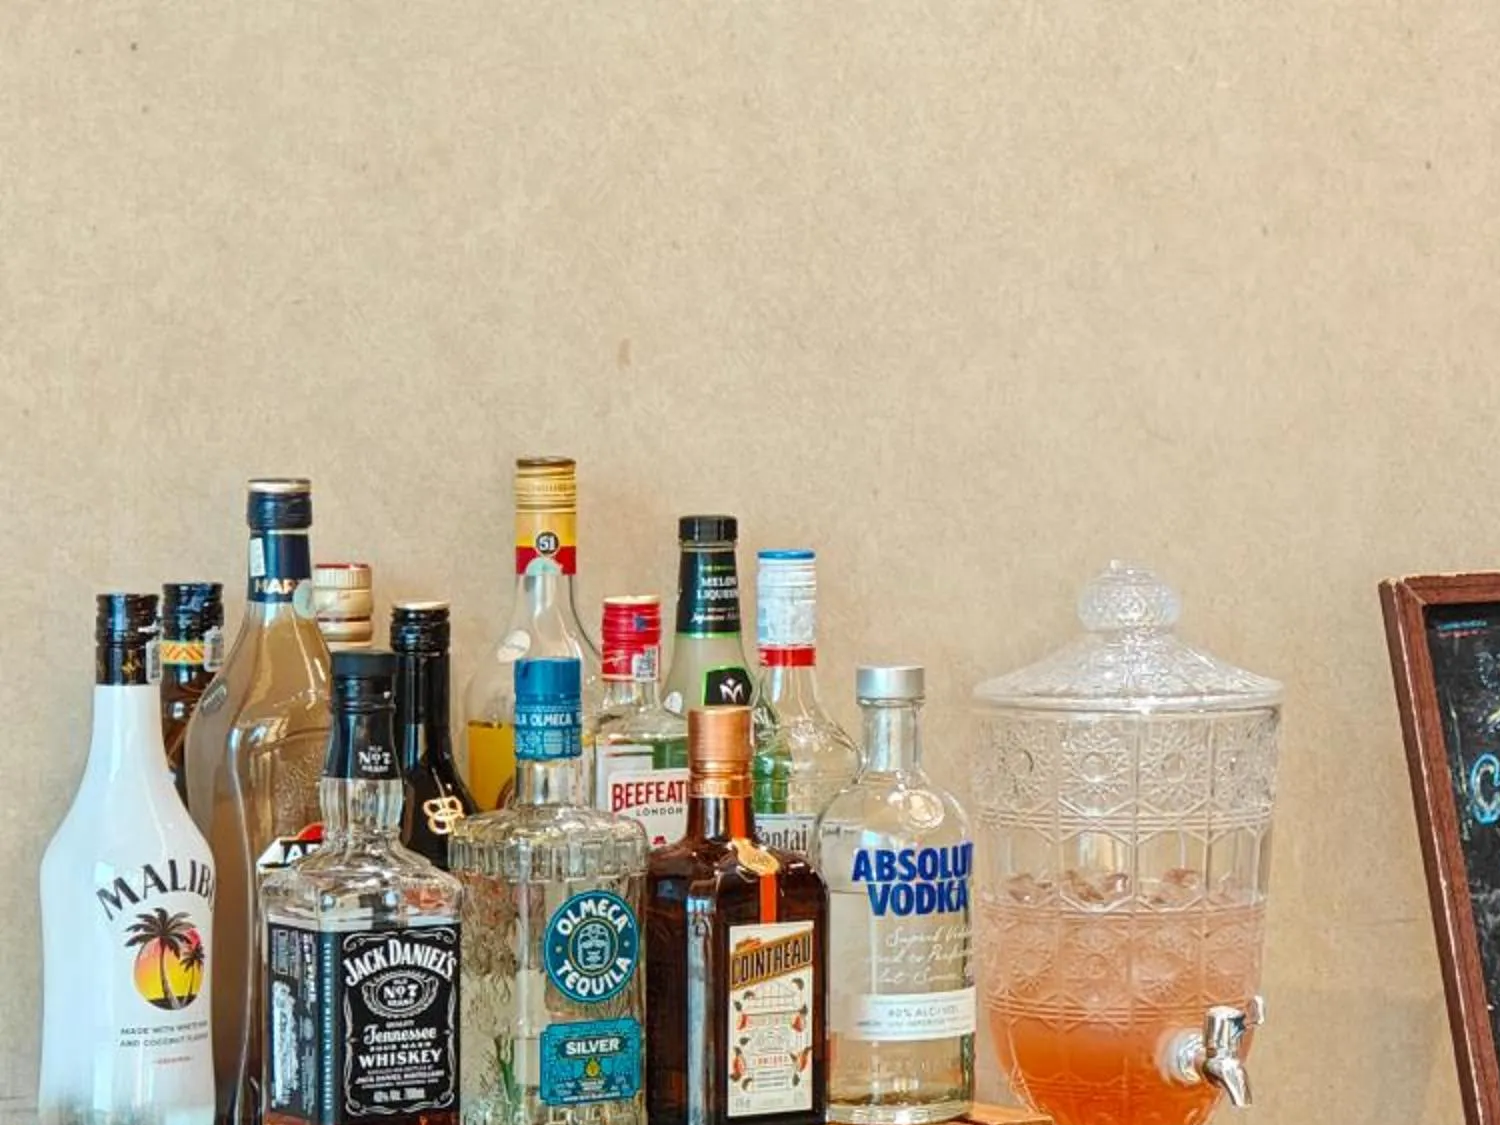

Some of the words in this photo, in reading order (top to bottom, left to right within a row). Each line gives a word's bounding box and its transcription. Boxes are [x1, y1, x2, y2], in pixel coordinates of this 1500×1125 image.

[612, 780, 690, 812] BEEFEAT
[635, 806, 683, 816] LONDON
[867, 879, 968, 917] VODKA
[556, 898, 630, 935] OLMECA
[342, 945, 388, 988] JACK
[387, 938, 458, 982] DANIEL'S
[556, 956, 632, 997] TEQUILA
[728, 932, 813, 988] COINTREAU
[363, 1023, 438, 1046] Tennessee
[564, 1037, 620, 1056] SILVER
[358, 1047, 443, 1070] WHISKEY
